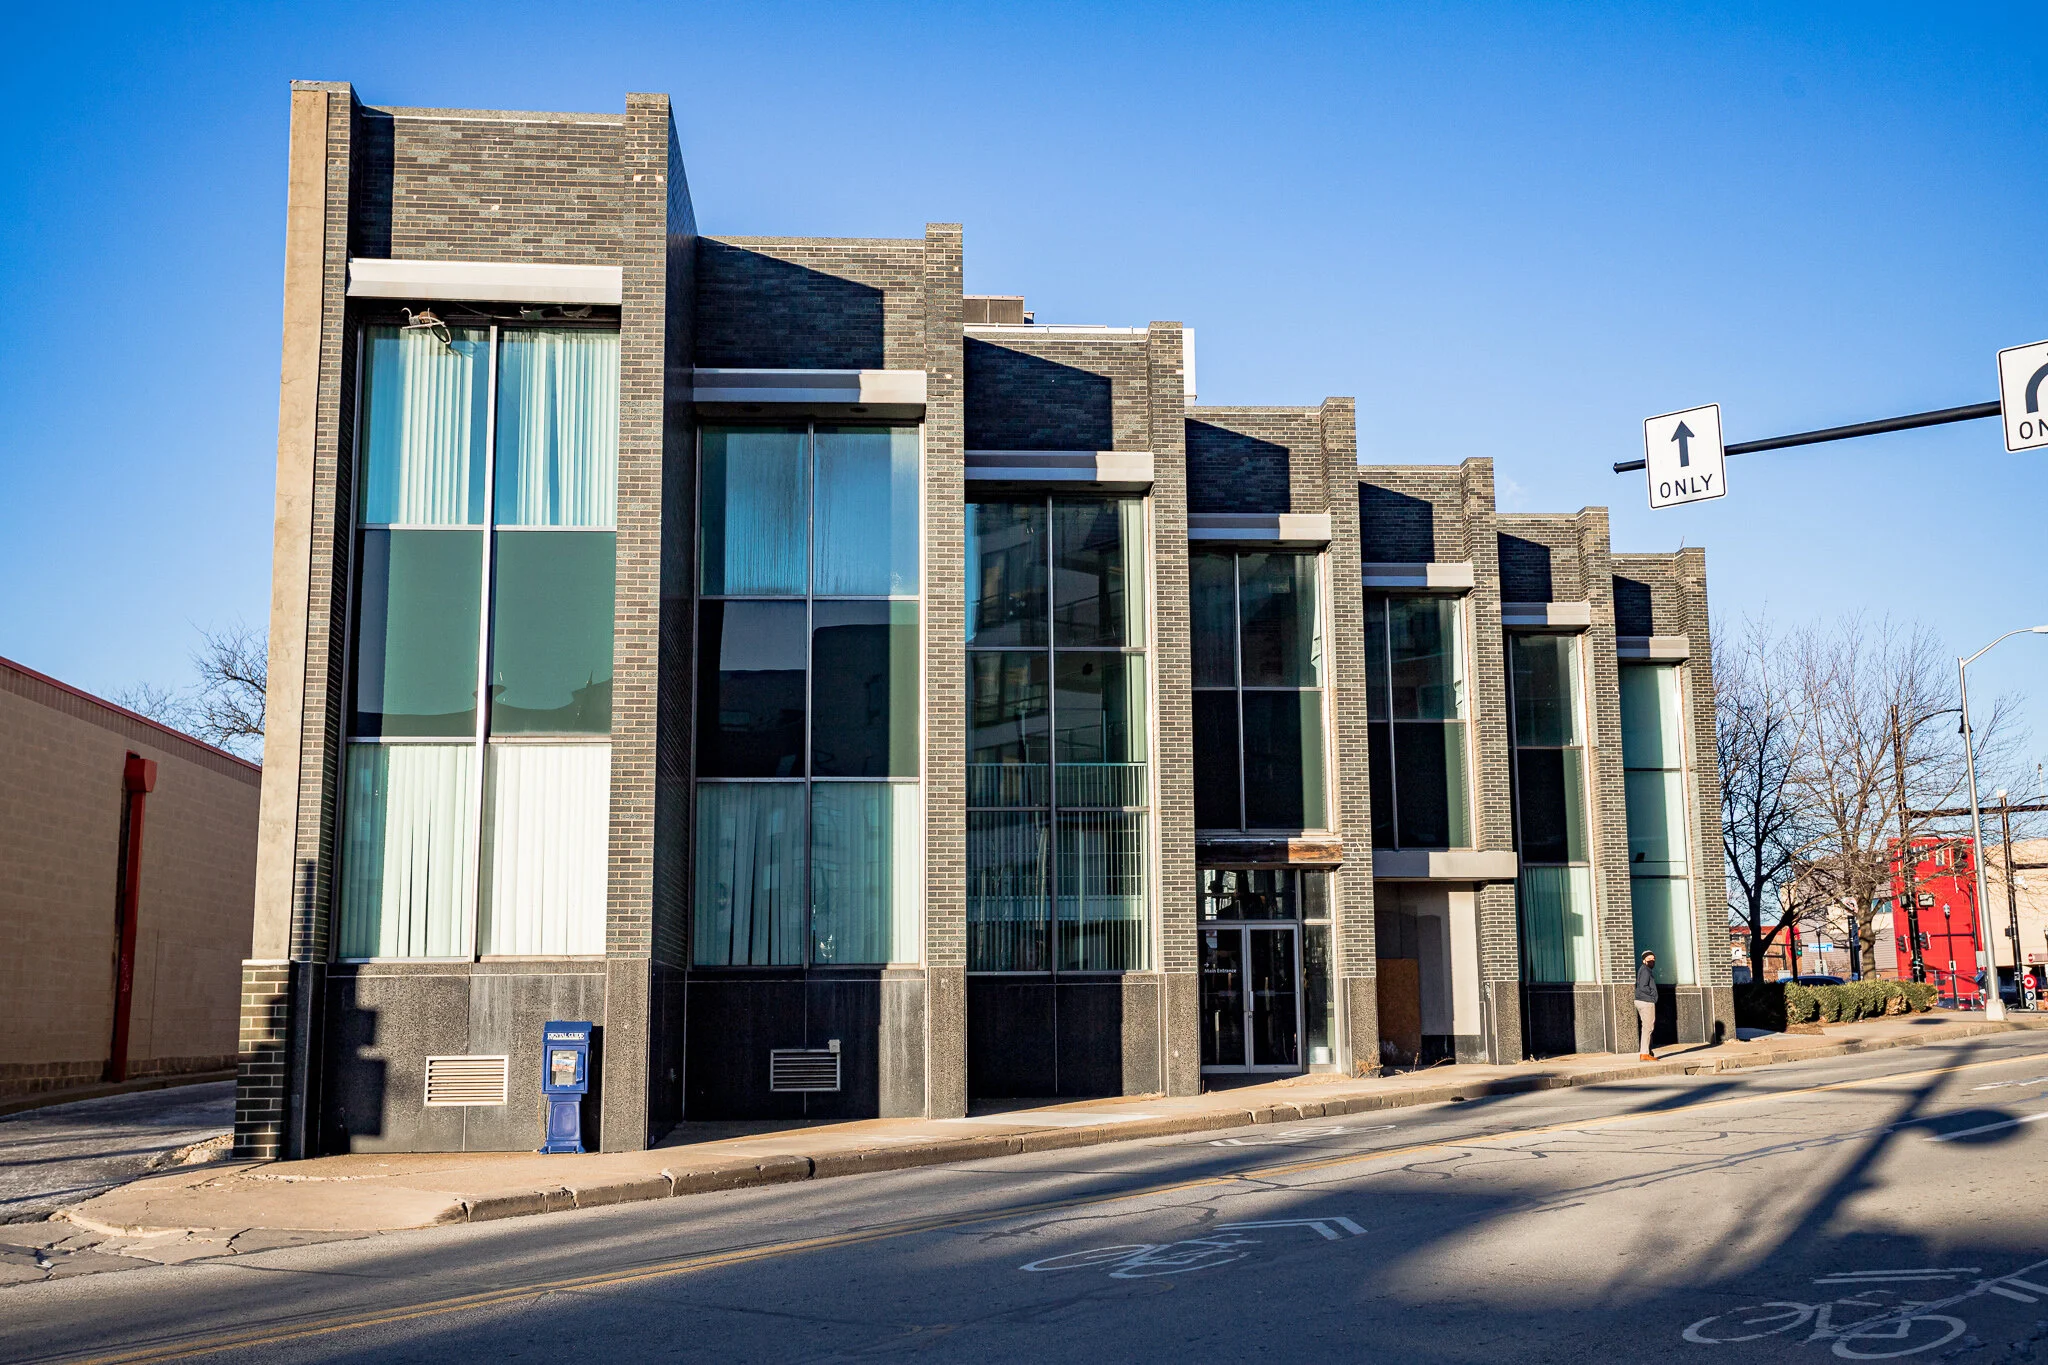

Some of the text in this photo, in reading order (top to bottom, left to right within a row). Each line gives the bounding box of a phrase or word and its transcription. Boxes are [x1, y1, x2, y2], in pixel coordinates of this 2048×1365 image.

[1660, 473, 1713, 498] ONLY
[547, 1032, 585, 1041] RENTAL GUIDE
